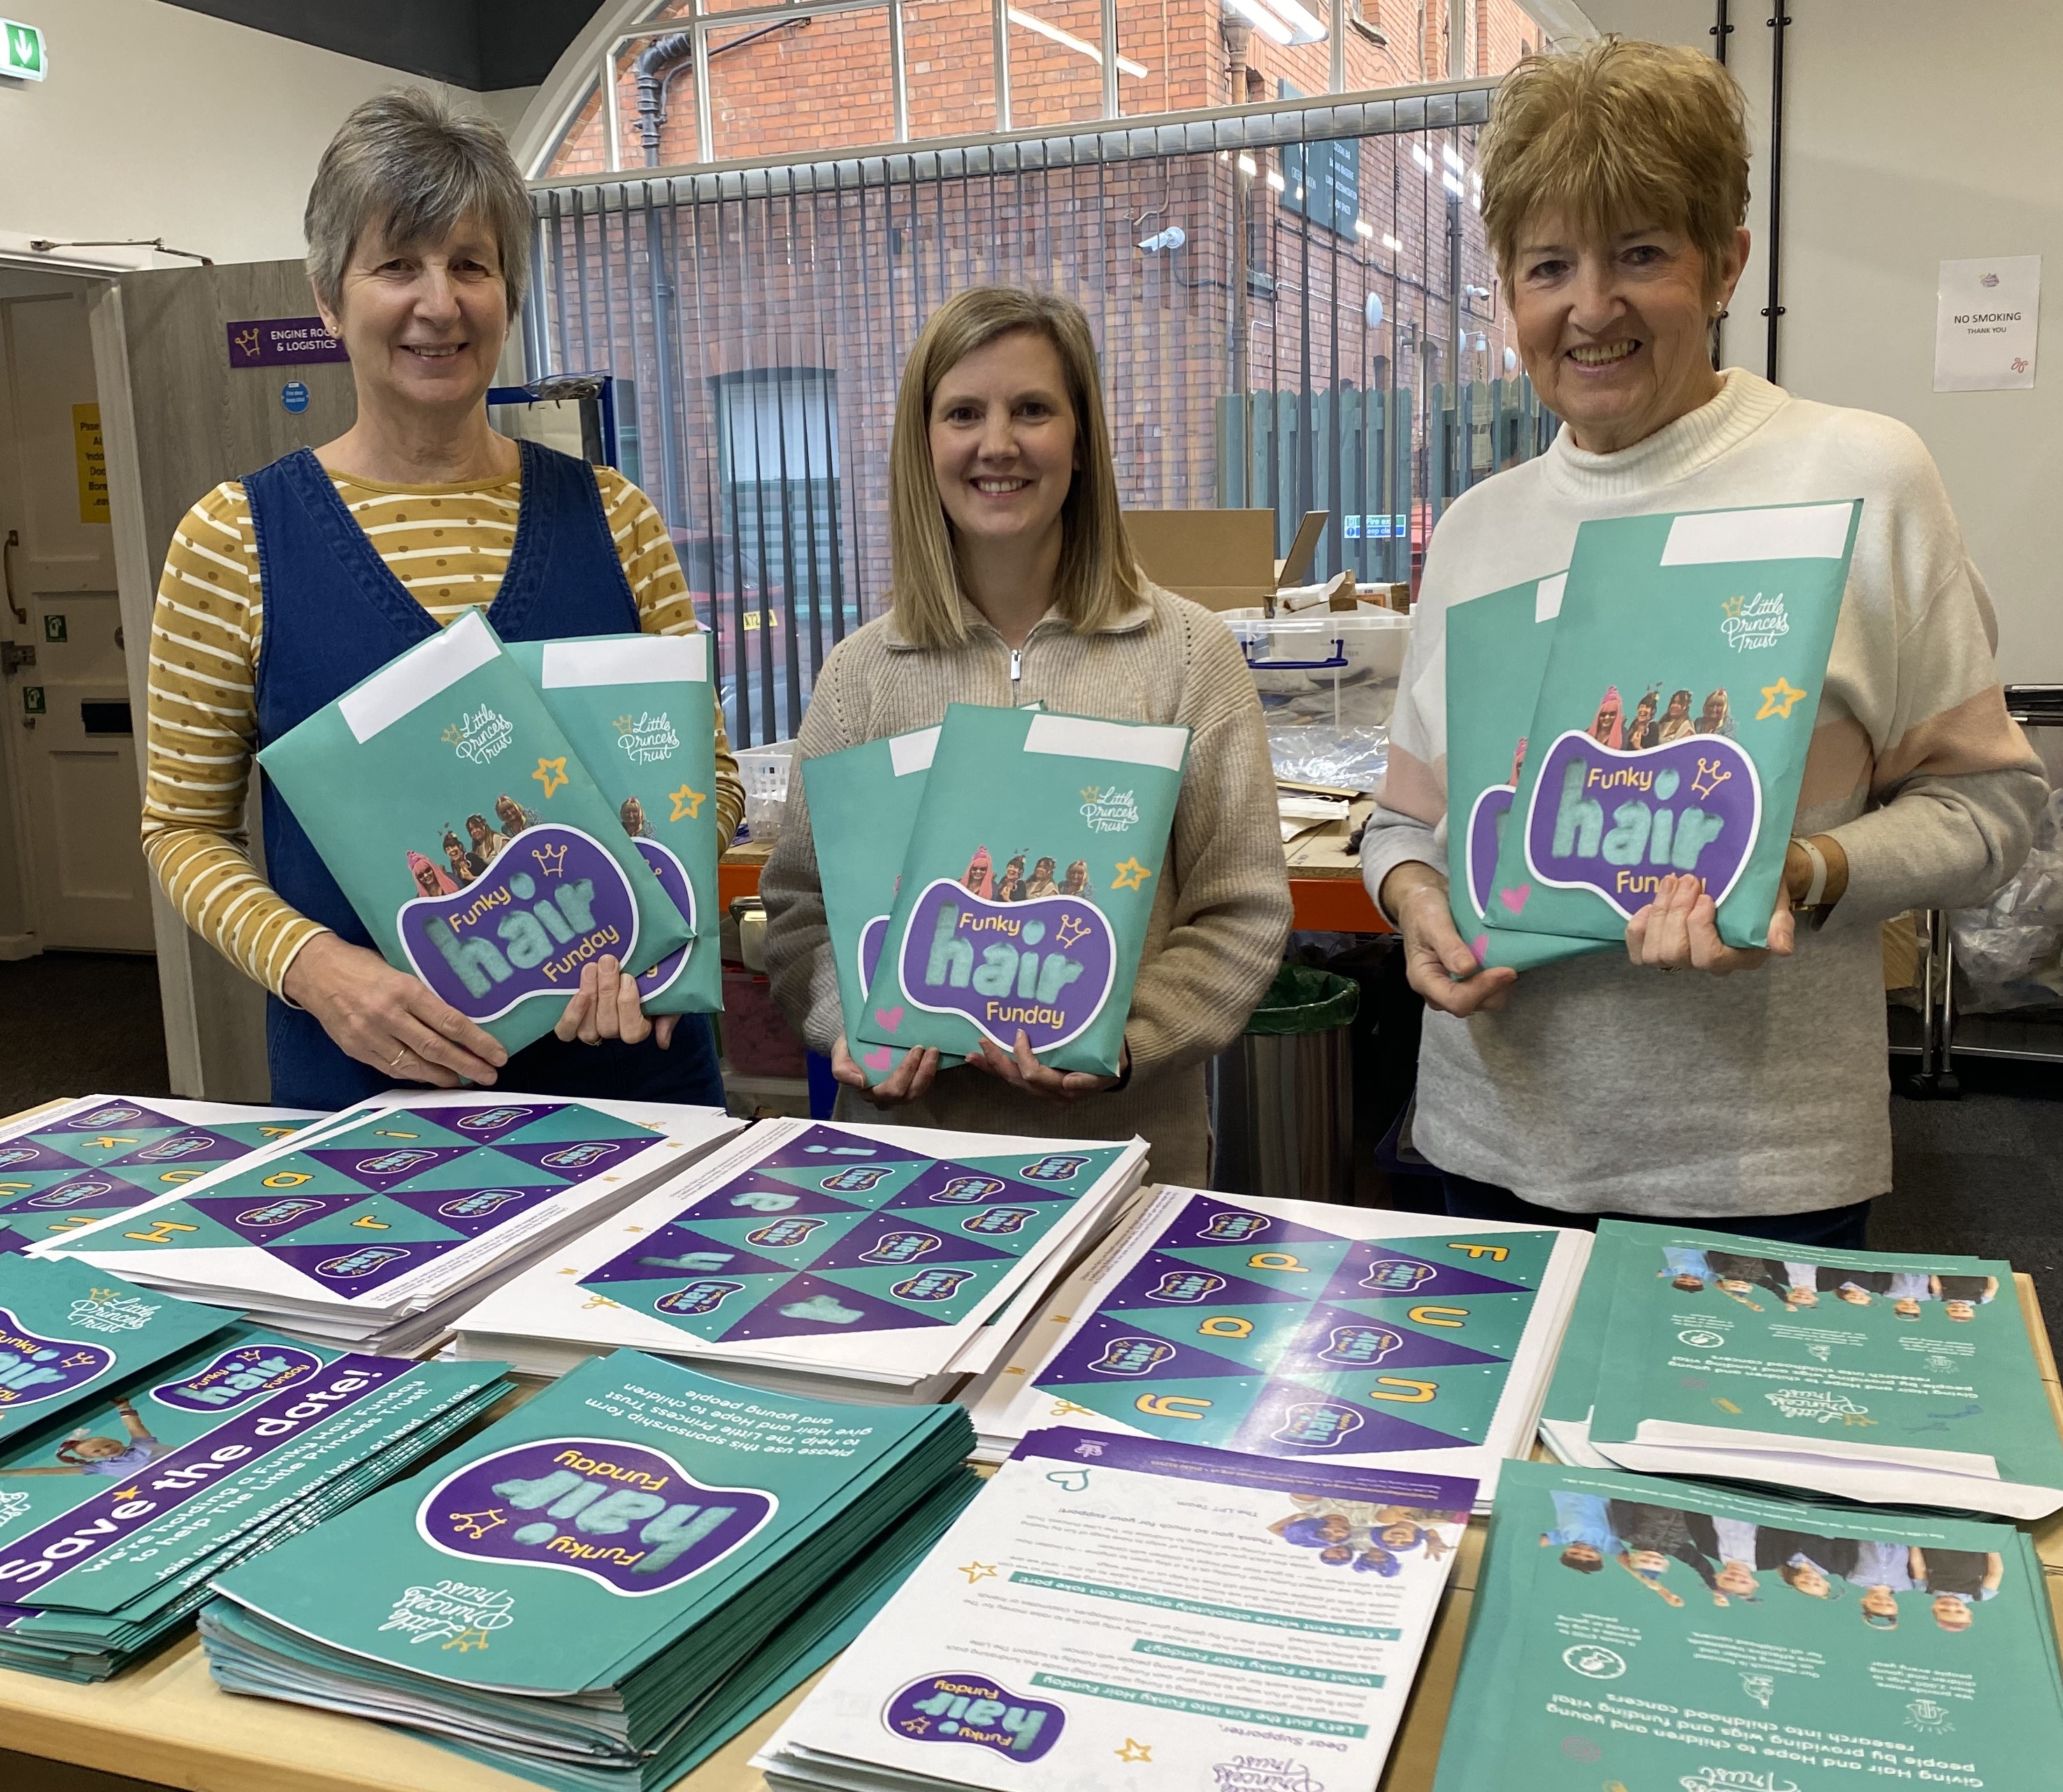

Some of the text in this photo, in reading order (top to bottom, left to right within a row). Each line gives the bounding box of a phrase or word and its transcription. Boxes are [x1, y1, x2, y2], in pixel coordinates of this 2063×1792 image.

[1954, 312, 2022, 324] NO SMOKING
[271, 329, 308, 341] ENGINE
[276, 340, 337, 352] & LOGISTICS
[1741, 592, 1785, 618] Little
[1721, 612, 1790, 636] Princess
[1730, 631, 1778, 653] Trust
[459, 703, 496, 740] Little
[631, 710, 671, 733] Little
[455, 713, 513, 762] Princess
[475, 734, 512, 764] Trust
[617, 729, 680, 753] Princess
[629, 746, 673, 766] Trust
[1587, 766, 1653, 791] Funky
[1098, 785, 1134, 808] Little
[1079, 803, 1139, 823] Princess
[1088, 817, 1130, 833] Trust
[1551, 757, 1725, 872] hair
[448, 884, 512, 933] Funky
[423, 872, 596, 999] hair
[959, 912, 1021, 937] Funky
[542, 923, 621, 982] Funday
[924, 902, 1084, 1005] hair
[986, 1001, 1065, 1030] Funday
[1446, 1242, 1509, 1262] F
[70, 1298, 152, 1329] Princess
[106, 1297, 162, 1317] Little
[66, 1313, 124, 1333] Trust
[173, 1356, 292, 1405] hair
[188, 1368, 229, 1390] Funky
[263, 1363, 310, 1389] Funday
[604, 1391, 861, 1448] to help The Little Princess Trust
[623, 1382, 873, 1438] give Hair and Hope to children
[684, 1389, 833, 1426] and young people
[584, 1398, 854, 1457] Please use this sponsorship form
[0, 1498, 156, 1583] Save
[152, 1444, 252, 1491] the
[254, 1369, 384, 1437] date!
[80, 1380, 426, 1572] We're holding a Funky Hair Funday
[129, 1388, 433, 1563] to help The Little Princess Trust!
[154, 1383, 481, 1580] Join us by styling your hair or head to raise
[553, 1449, 669, 1491] Funday
[491, 1470, 738, 1575] hair
[546, 1535, 645, 1567] Funky
[430, 1579, 515, 1608] Trust
[1056, 1582, 1086, 1593] take
[1090, 1587, 1116, 1598] can
[1119, 1593, 1172, 1607] anyone
[391, 1587, 514, 1630] Princess
[1176, 1601, 1251, 1623] absolutely
[378, 1608, 466, 1644] Little
[1255, 1617, 1300, 1630] where
[1304, 1622, 1346, 1635] event
[1349, 1629, 1374, 1639] fun
[1377, 1631, 1390, 1640] A
[1143, 1644, 1208, 1663] Funday?
[1213, 1656, 1245, 1669] Hair
[1249, 1659, 1295, 1676] Funky
[1314, 1671, 1327, 1680] is
[1330, 1673, 1372, 1687] What
[933, 1679, 999, 1700] Funday
[1042, 1676, 1355, 1736] Let's put the fun into Funky Hair Funday
[912, 1691, 1048, 1751] hair
[1683, 1708, 1779, 1733] childhood
[1783, 1726, 1823, 1739] into
[958, 1726, 1013, 1747] Funky
[1218, 1724, 1349, 1754] Dear Supporter,
[1546, 1703, 1984, 1789] Giving Hair and Hope to children and young
[1552, 1693, 1976, 1774] people by providing wigs and funding vital
[1827, 1732, 1915, 1753] research
[1231, 1754, 1307, 1777] Trust
[1696, 1767, 1799, 1792] Trust
